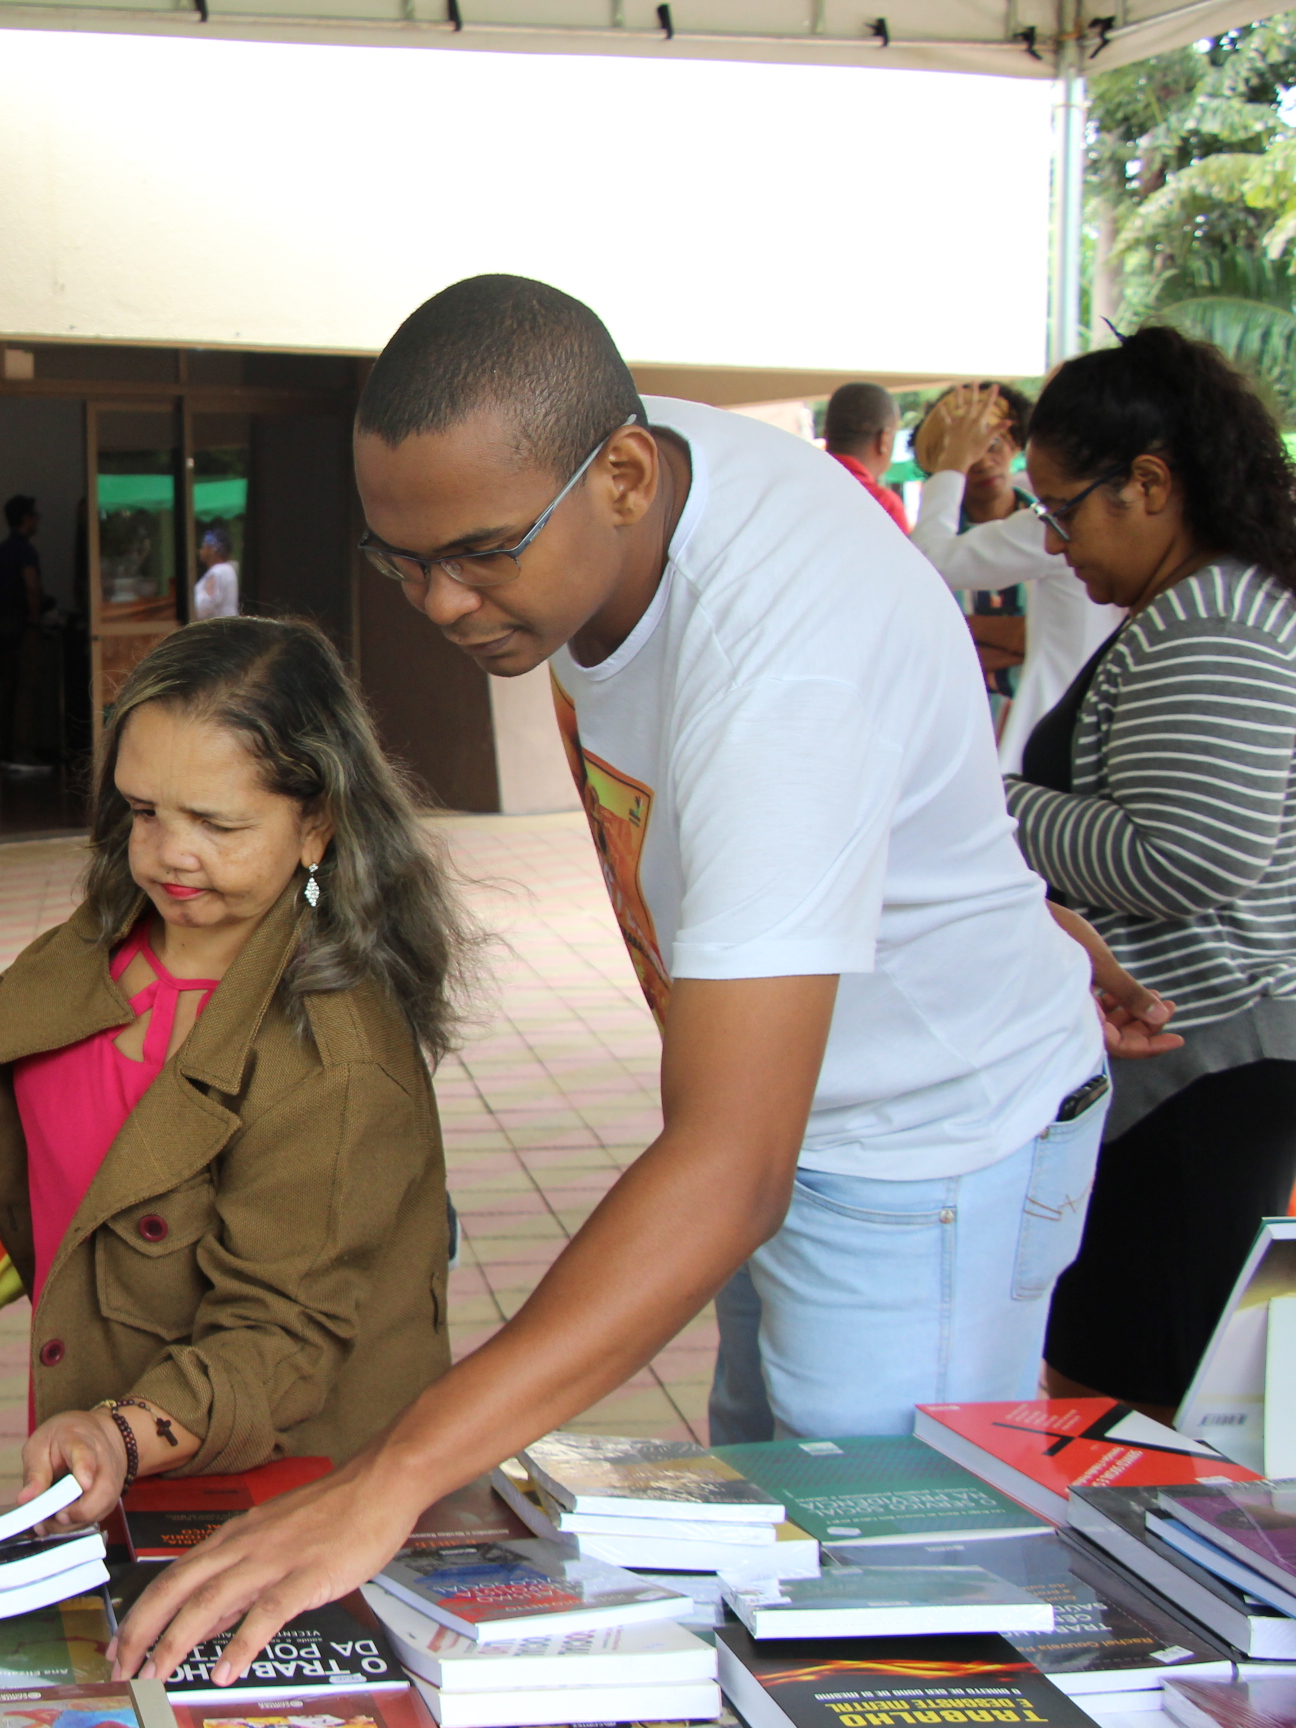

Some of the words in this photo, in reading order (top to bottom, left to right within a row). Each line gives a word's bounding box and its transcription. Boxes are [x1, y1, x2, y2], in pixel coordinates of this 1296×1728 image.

[952, 1490, 989, 1500] NA
[798, 1492, 949, 1510] PREVIDÊNCIA
[889, 1498, 977, 1512] SERVIÇO
[979, 1498, 999, 1507] O
[807, 1503, 885, 1518] SOCIAL
[1052, 1602, 1109, 1613] SAÚD
[329, 1639, 380, 1656] DA
[1101, 1637, 1155, 1648] Rachel
[360, 1656, 389, 1674] O
[43, 1667, 70, 1676] Ana
[813, 1690, 860, 1701] MESMO
[891, 1688, 924, 1697] DONO
[965, 1687, 1010, 1696] DIREITO
[823, 1699, 910, 1714] MENTAL
[911, 1697, 1012, 1710] DESGASTE
[1015, 1698, 1035, 1708] E
[838, 1708, 1049, 1728] TRABALHO
